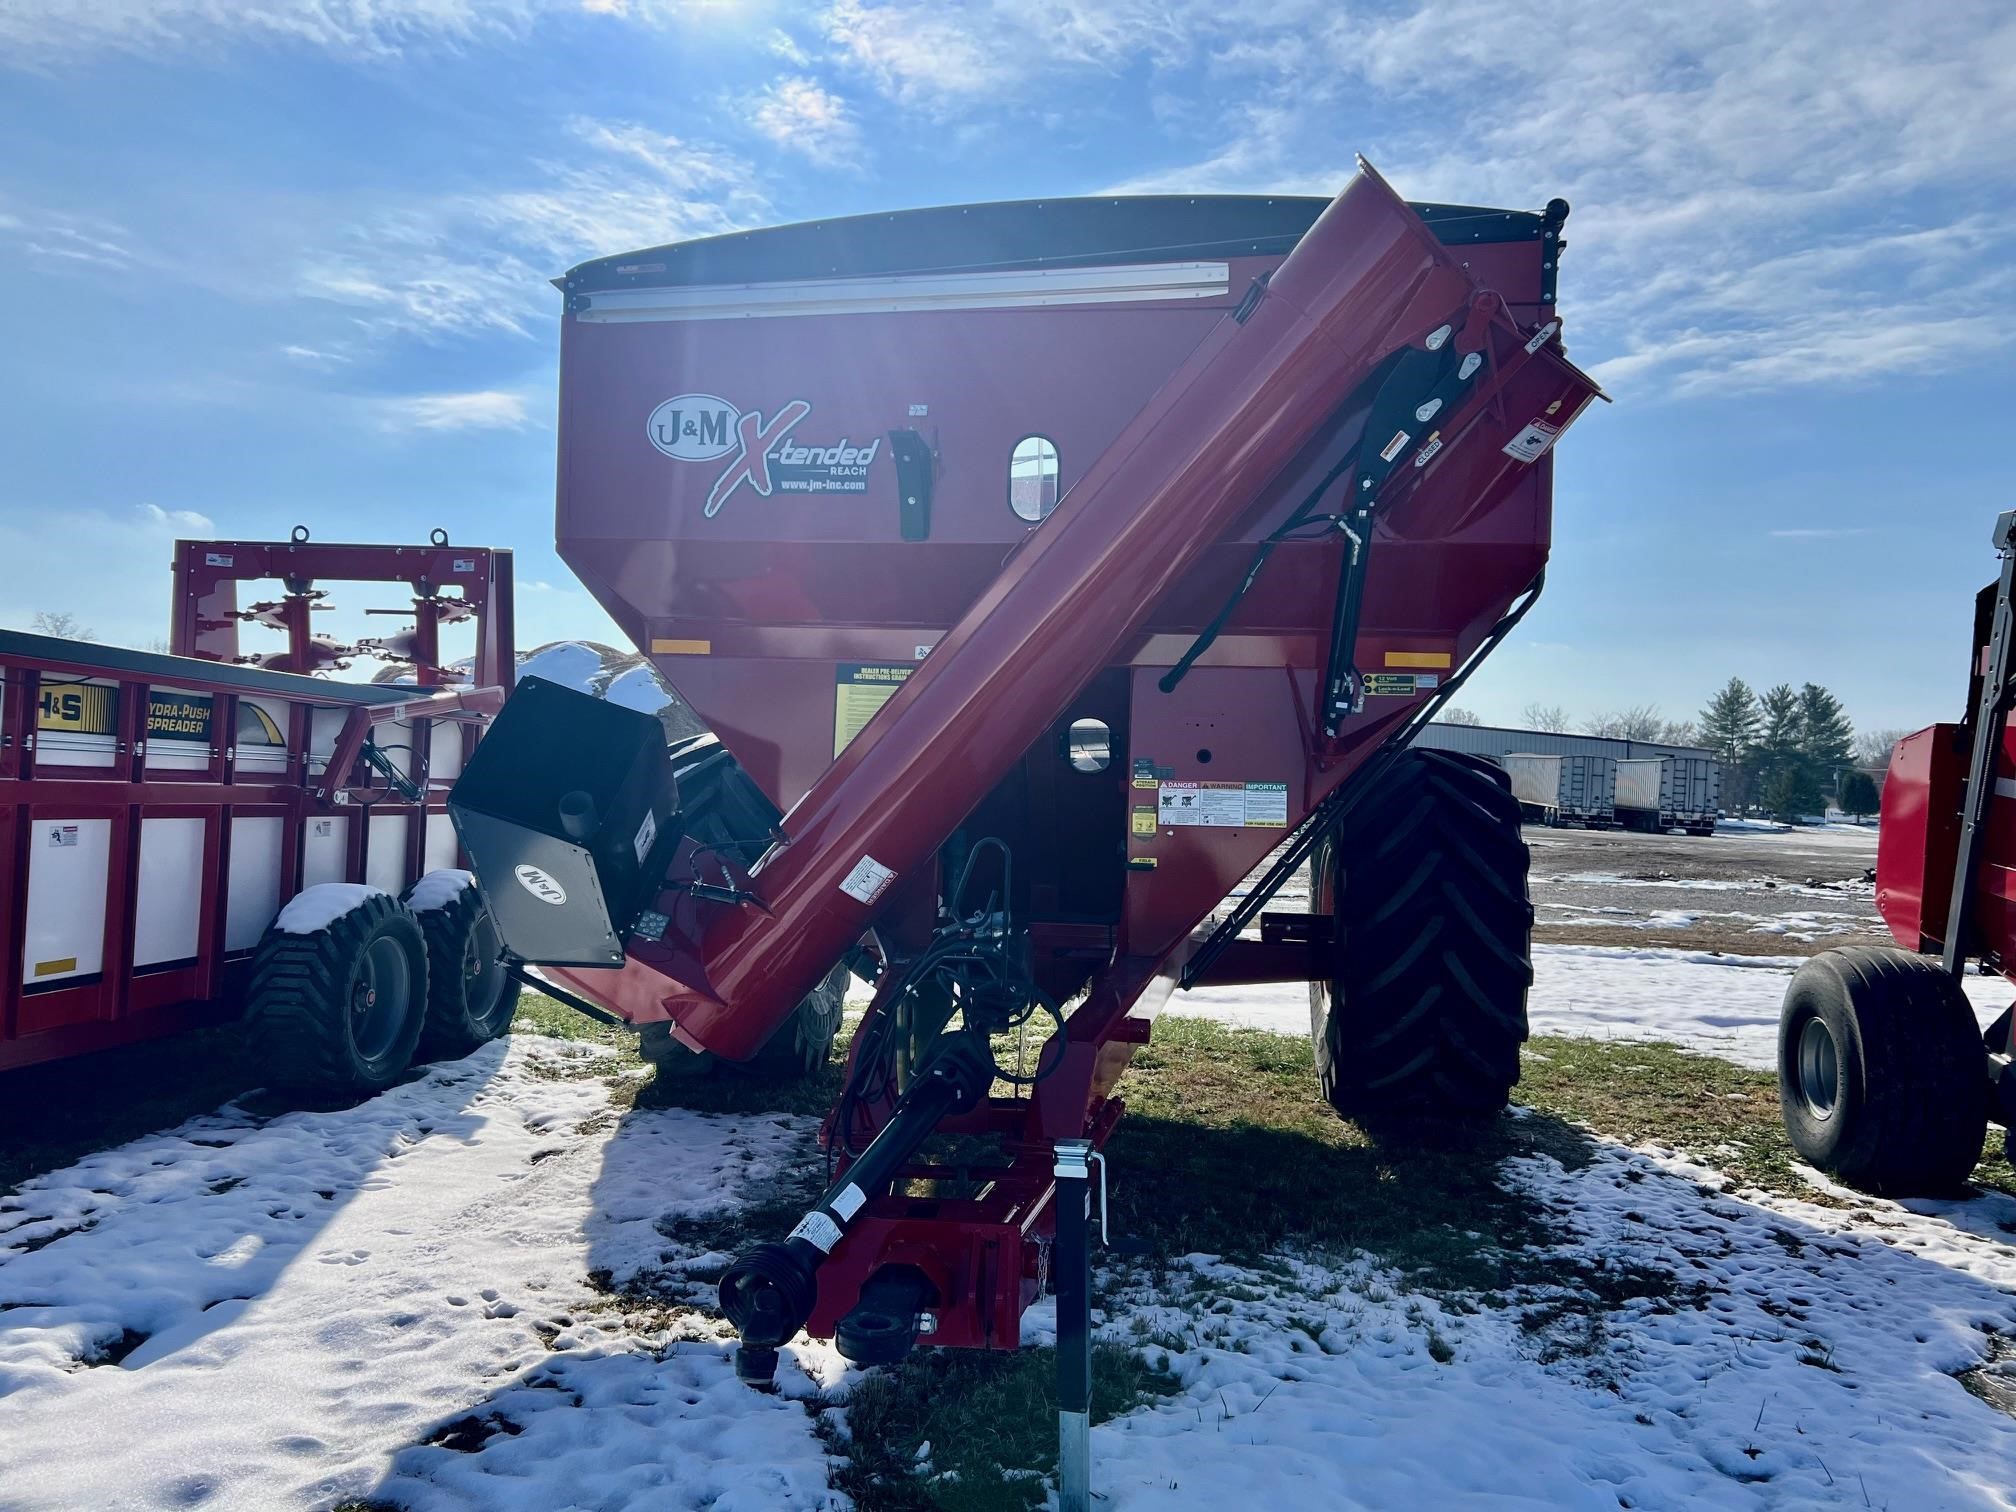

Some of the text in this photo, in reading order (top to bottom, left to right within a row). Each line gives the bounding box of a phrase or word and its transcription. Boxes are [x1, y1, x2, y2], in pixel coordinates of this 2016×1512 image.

[1531, 329, 1550, 348] OPEN
[656, 409, 729, 447] J&M
[1416, 440, 1441, 464] CLOSED
[830, 466, 867, 476] REACH
[147, 717, 204, 733] SPREADER
[519, 868, 562, 901] J&M
